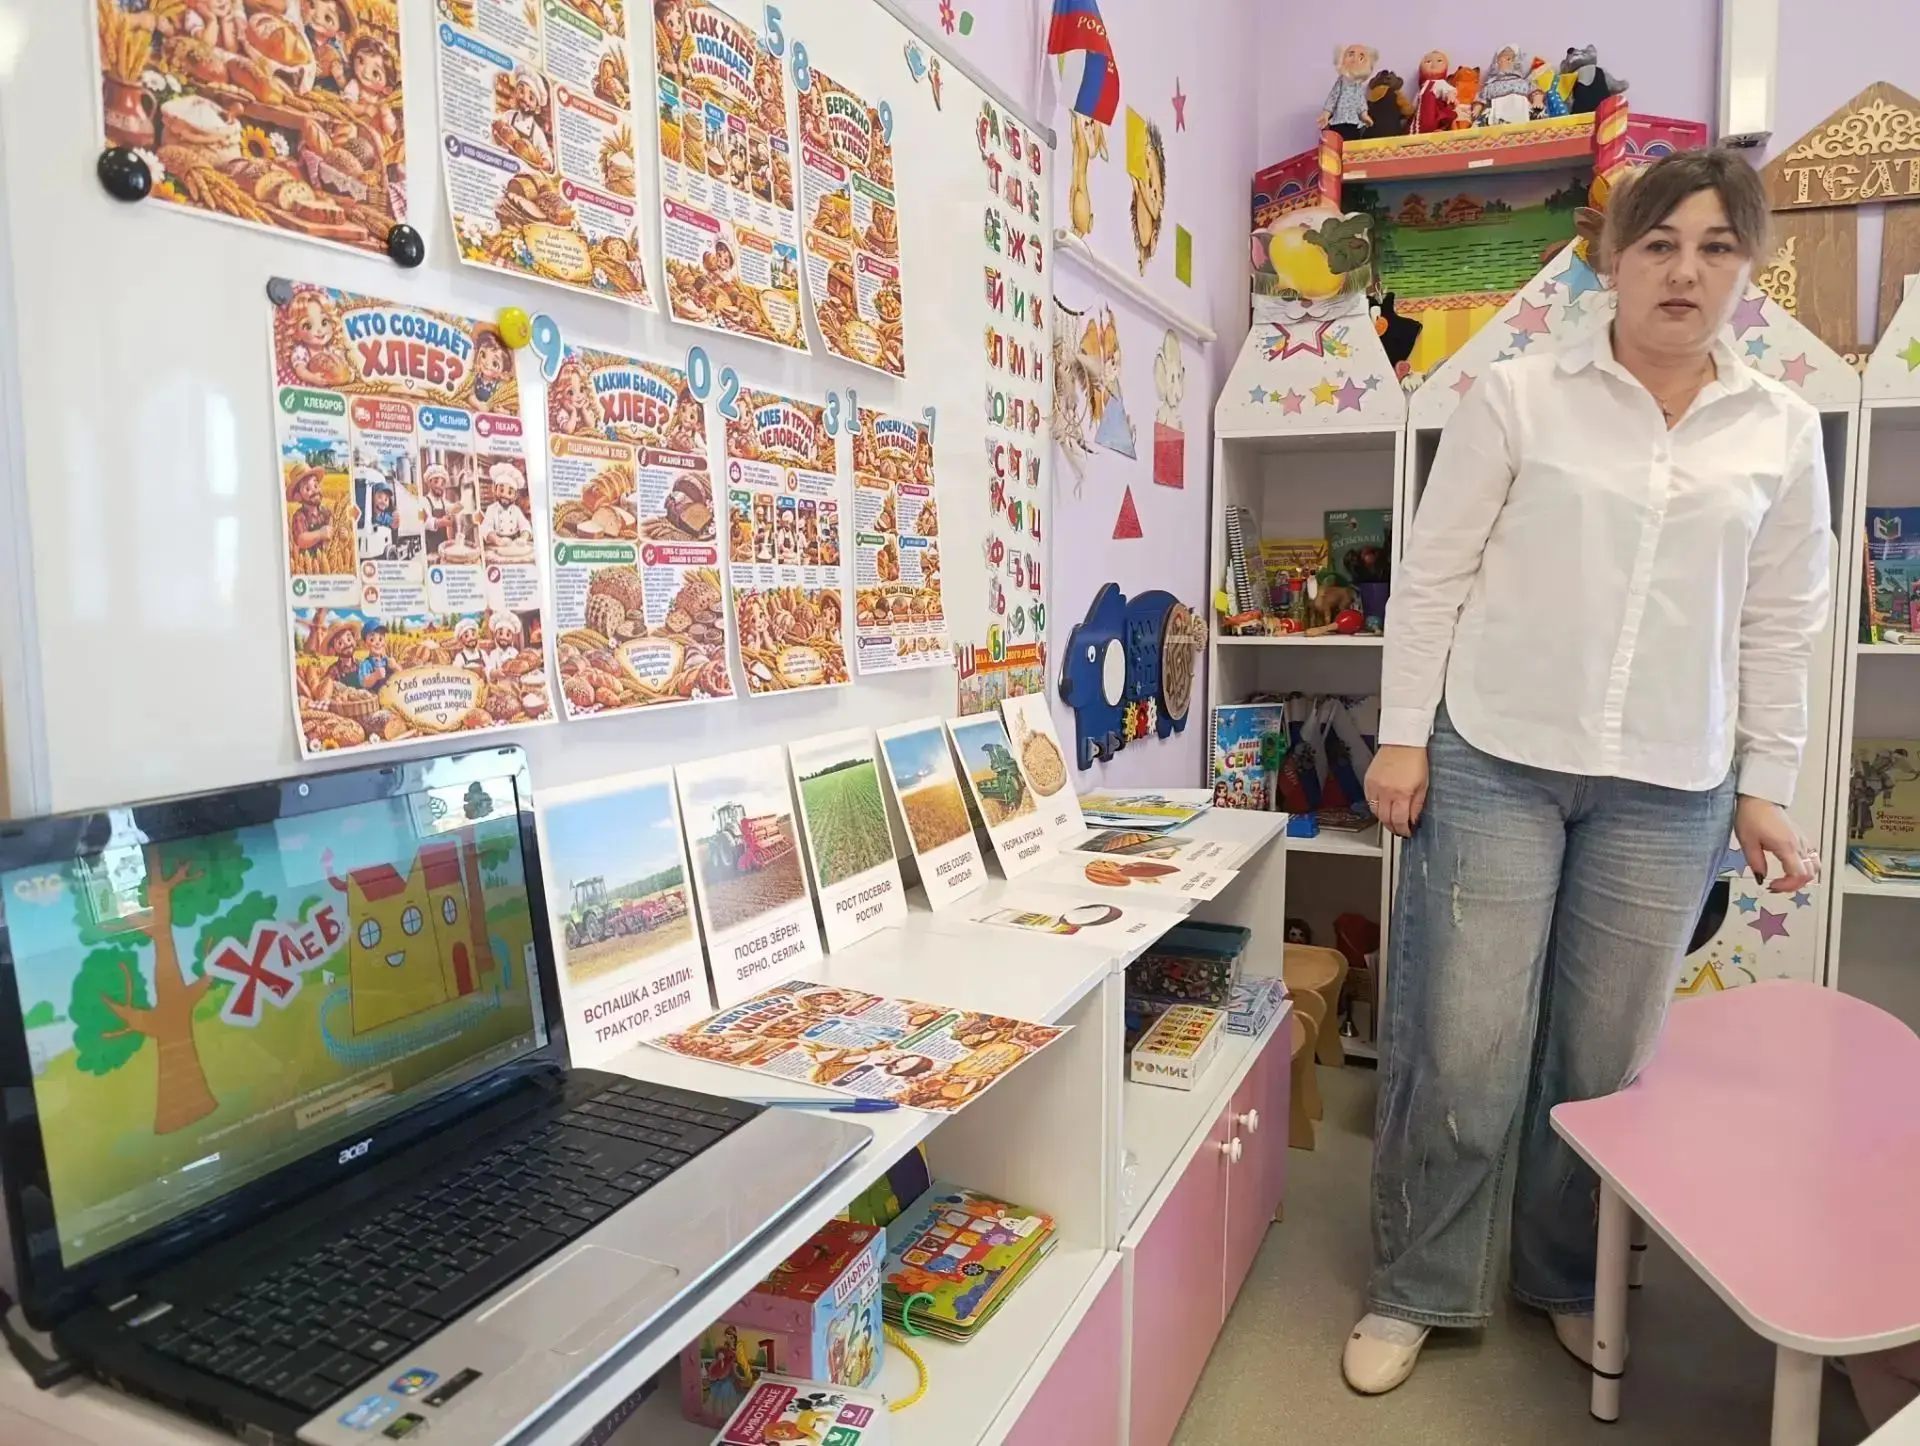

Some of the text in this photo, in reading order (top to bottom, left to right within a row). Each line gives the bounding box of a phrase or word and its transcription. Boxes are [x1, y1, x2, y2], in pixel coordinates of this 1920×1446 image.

[688, 11, 754, 67] КАК ХЛЕБ
[767, 5, 784, 57] 5
[696, 36, 751, 81] ПОПАДАЕТ
[793, 41, 810, 91] 8
[690, 56, 757, 105] НА НАШ СТОЛ?
[825, 95, 870, 136] БЕРЕЖНО
[828, 117, 870, 149] ОТНОСИМСЯ
[879, 101, 893, 144] 9
[832, 132, 841, 148] К
[841, 133, 869, 165] ХЛЕБУ
[344, 312, 473, 361] КТО СОЗДАЁТ
[531, 315, 562, 376] 9
[357, 340, 464, 392] ХЛЕБ?
[688, 347, 711, 399] 0
[303, 397, 344, 412] ХЛЕБОРОБ
[379, 402, 408, 413] ВОДИТЕЛЬ
[593, 372, 675, 408] КАКИМ БЫВАЕТ
[719, 368, 740, 418] 2
[439, 415, 468, 427] МЕЛЬНИК
[495, 422, 519, 433] ПЕКАРЬ
[601, 393, 670, 435] ХЛЕБ?
[755, 407, 813, 443] ХЛЕБ И ТРУД
[824, 391, 840, 436] 3
[847, 389, 860, 432] 1
[924, 406, 936, 445] 7
[759, 428, 809, 459] ЧЕЛОВЕКА
[876, 420, 917, 442] ПОЧЕМУ ХЛЕБ
[877, 434, 917, 457] ТАК ВАЖЕН?
[567, 443, 628, 459] ПШЕНИЧНЫЙ ХЛЕБ
[659, 454, 695, 468] РЖАНОЙ ХЛЕБ
[1329, 512, 1348, 521] МИР
[621, 550, 634, 559] ХЛЕБ
[394, 672, 471, 694] Хлеб появляется
[404, 687, 473, 704] благодаря труду
[414, 700, 443, 715] многих
[1001, 834, 1023, 853] УБОРКА
[13, 873, 62, 899] СТС
[935, 860, 952, 877] ХЛЕБ
[947, 869, 973, 889] КОЛОСЬЯ
[836, 880, 893, 914] РОСТ ПОСЕВОВ:
[855, 903, 884, 924] РОСТКИ
[734, 922, 801, 961] ПОСЕВ ЗЁРЕН:
[736, 940, 806, 981] ЗЕРНО, СЕЯЛКА
[583, 967, 694, 1025] ВСПАШКА ЗЕМЛИ:
[595, 990, 692, 1043] ТРАКТОР, ЗЕМЛЯ
[703, 995, 793, 1035] ИЗ ЧЕГО ПЕКУТ
[726, 1002, 799, 1034] ХЛЕБ?
[1133, 1060, 1189, 1079] ТОМИК
[338, 1137, 374, 1165] acer
[836, 1253, 872, 1301] ЦИФРЫ
[757, 1338, 775, 1374] 1
[739, 1388, 782, 1437] ЖИВОТНЫЕ
